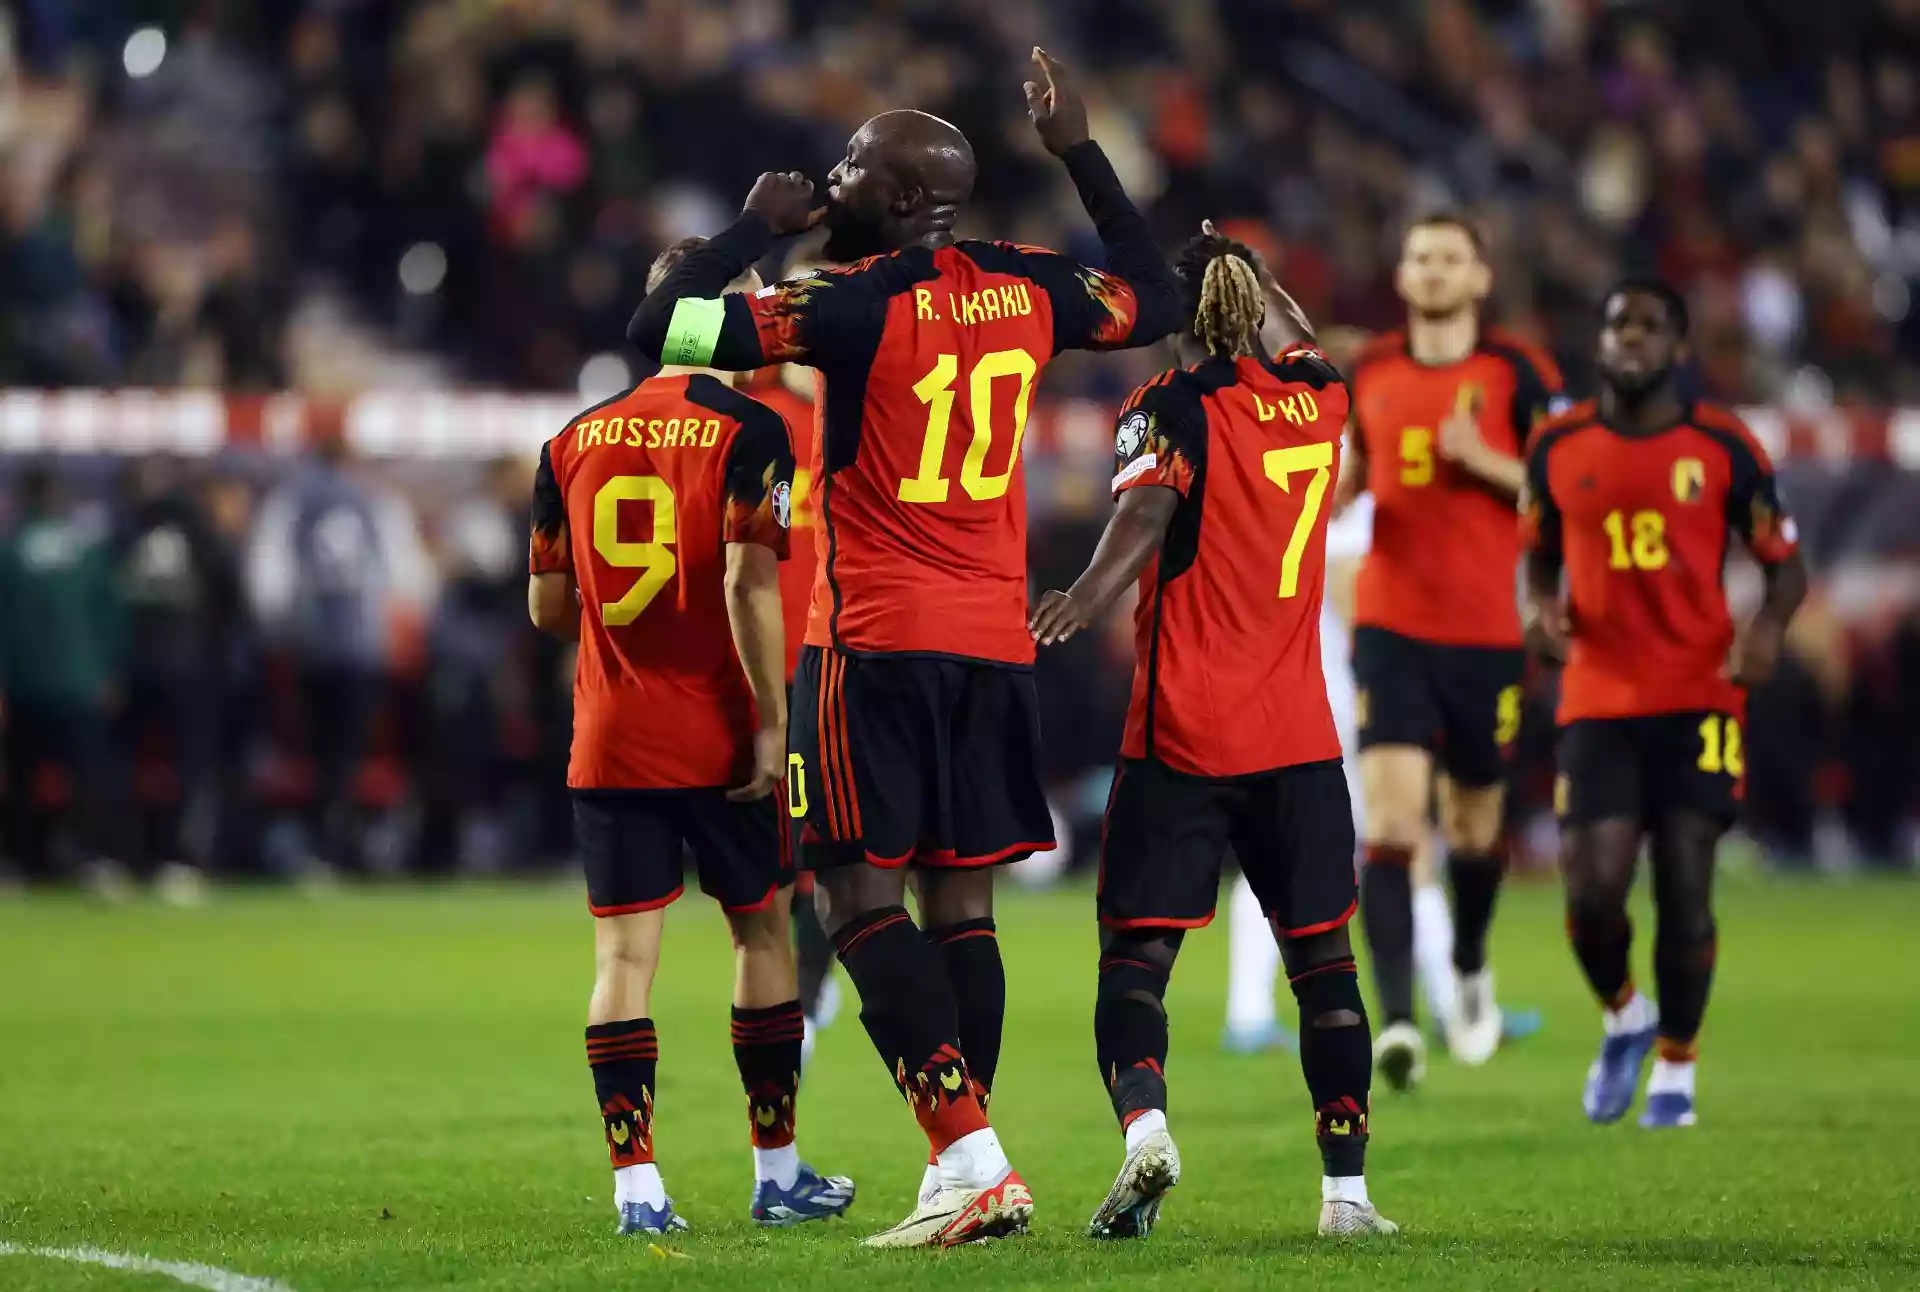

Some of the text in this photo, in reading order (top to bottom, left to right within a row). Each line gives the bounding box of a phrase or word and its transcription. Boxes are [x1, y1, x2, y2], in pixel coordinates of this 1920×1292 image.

[916, 288, 941, 320] R.
[576, 416, 721, 452] TROSSARD
[898, 348, 1037, 503] 10
[593, 475, 677, 626] 9
[1262, 441, 1334, 599] 7
[1603, 509, 1669, 571] 18
